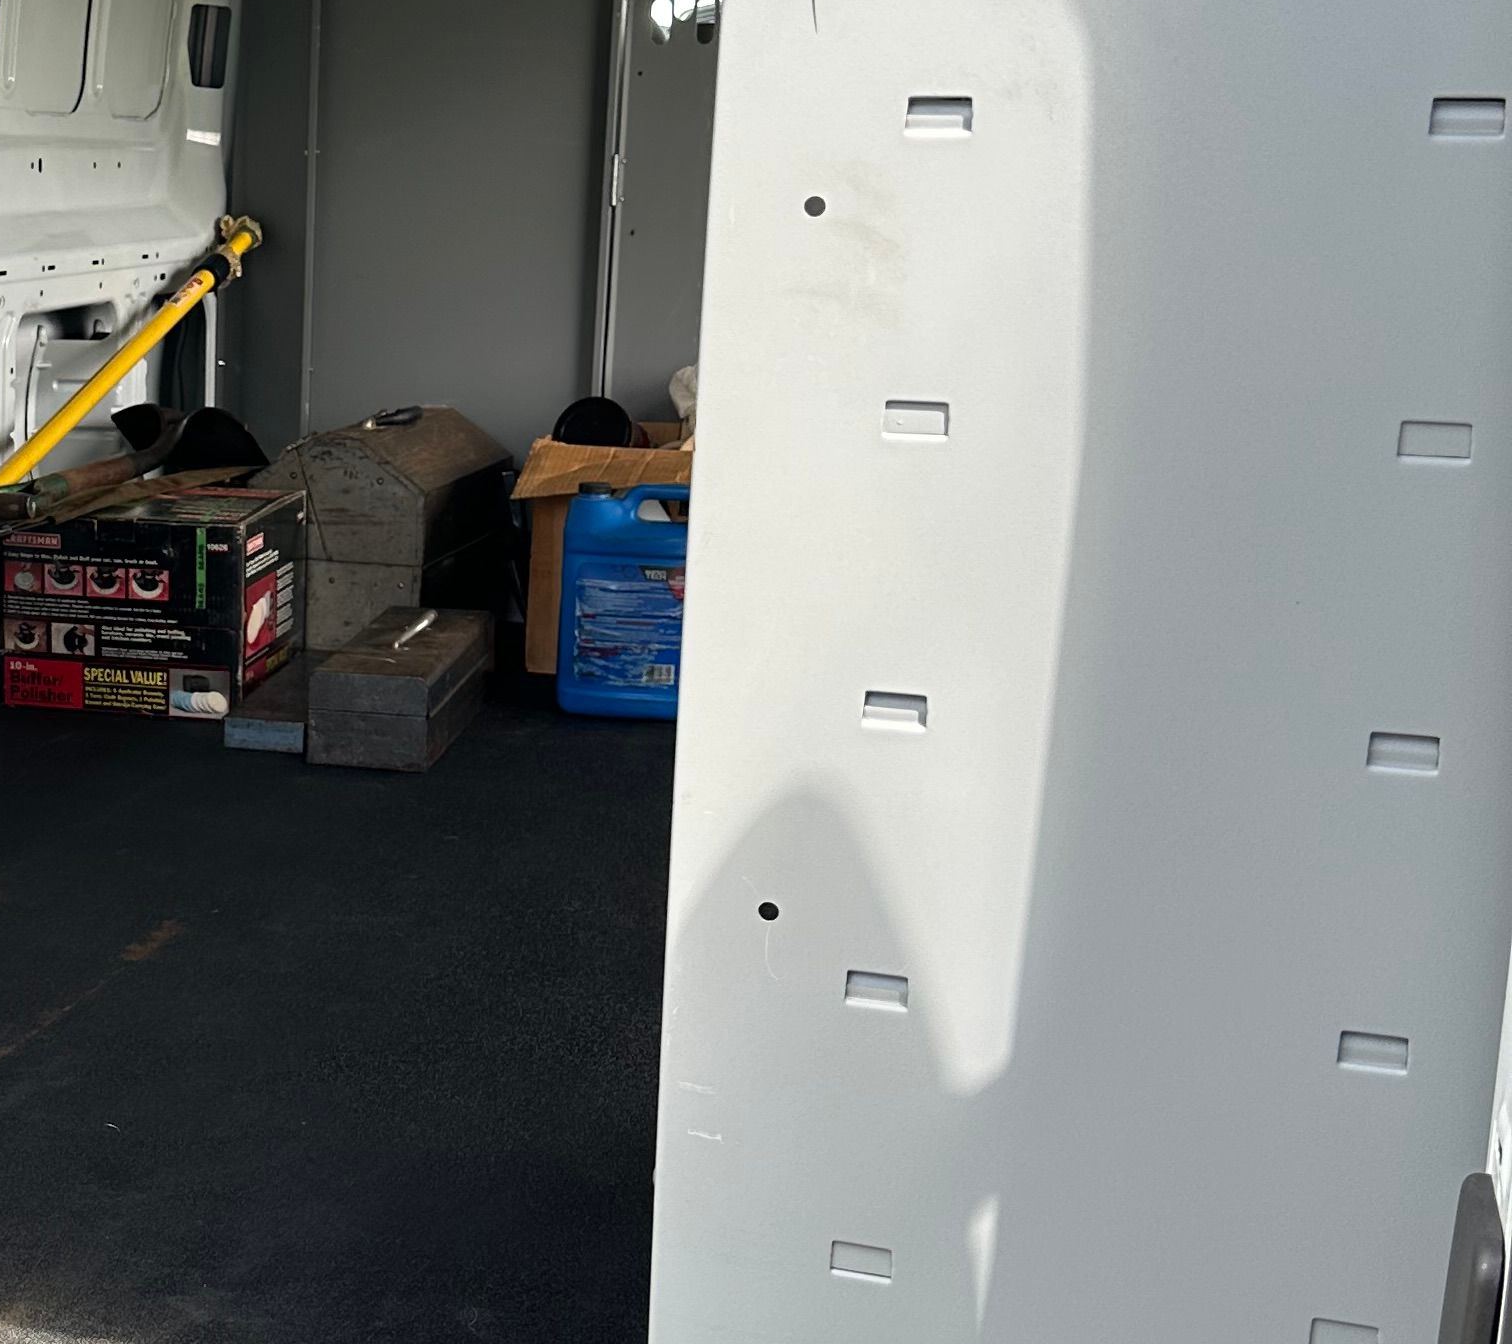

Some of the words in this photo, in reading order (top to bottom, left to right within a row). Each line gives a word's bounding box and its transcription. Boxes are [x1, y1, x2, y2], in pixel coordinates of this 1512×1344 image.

[83, 667, 130, 683] SPECIAL
[130, 669, 168, 686] VALUE!
[10, 684, 73, 704] Polisher
